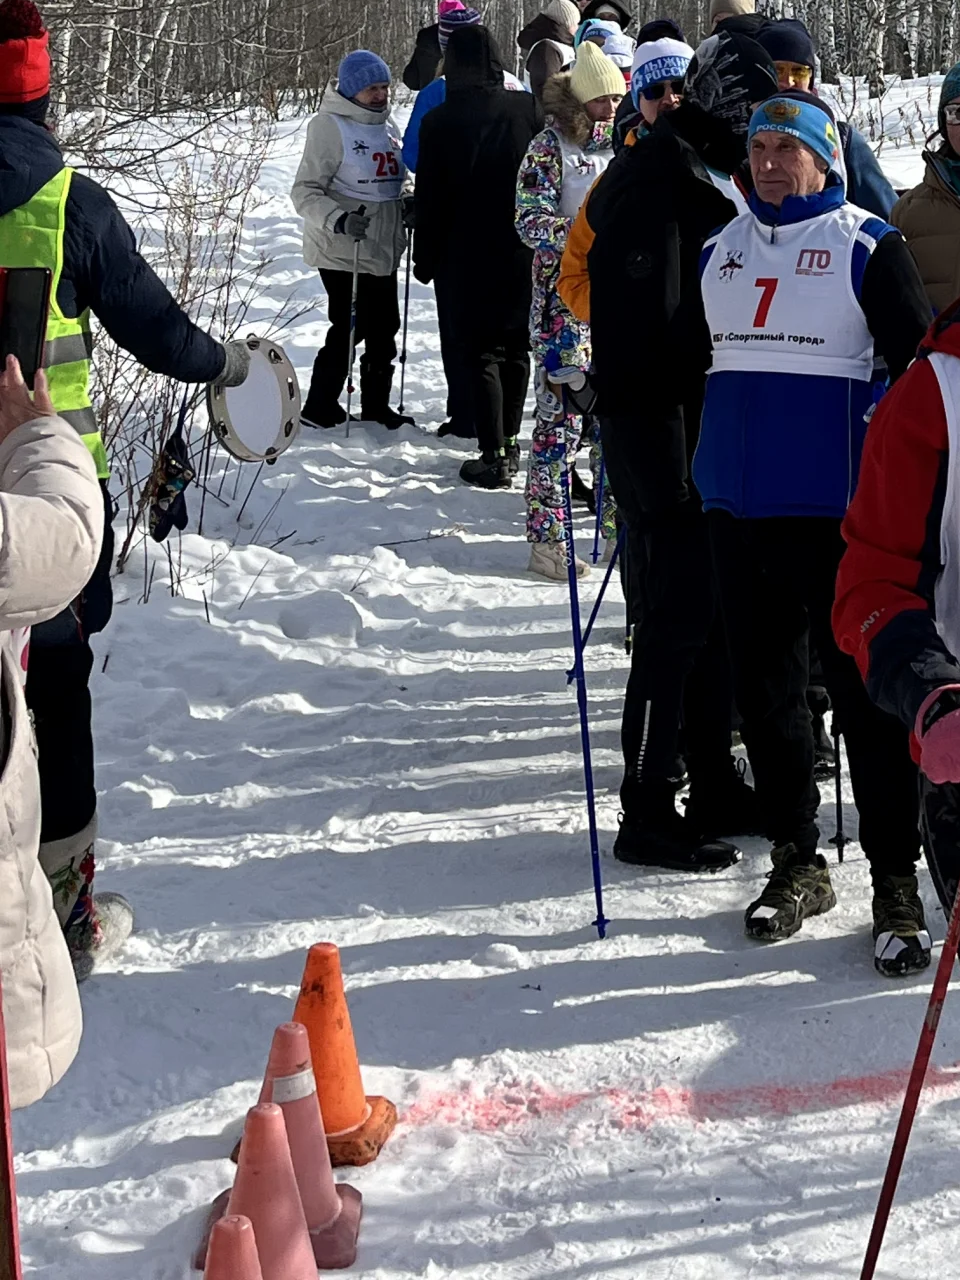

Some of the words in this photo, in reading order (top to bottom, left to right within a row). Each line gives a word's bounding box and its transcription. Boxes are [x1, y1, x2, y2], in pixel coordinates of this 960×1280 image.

[756, 124, 800, 138] РОССИЯ
[372, 151, 399, 177] 25
[796, 248, 832, 269] ГТО
[753, 277, 779, 328] 7
[725, 332, 784, 344] «Спортивный
[787, 334, 826, 345] город»
